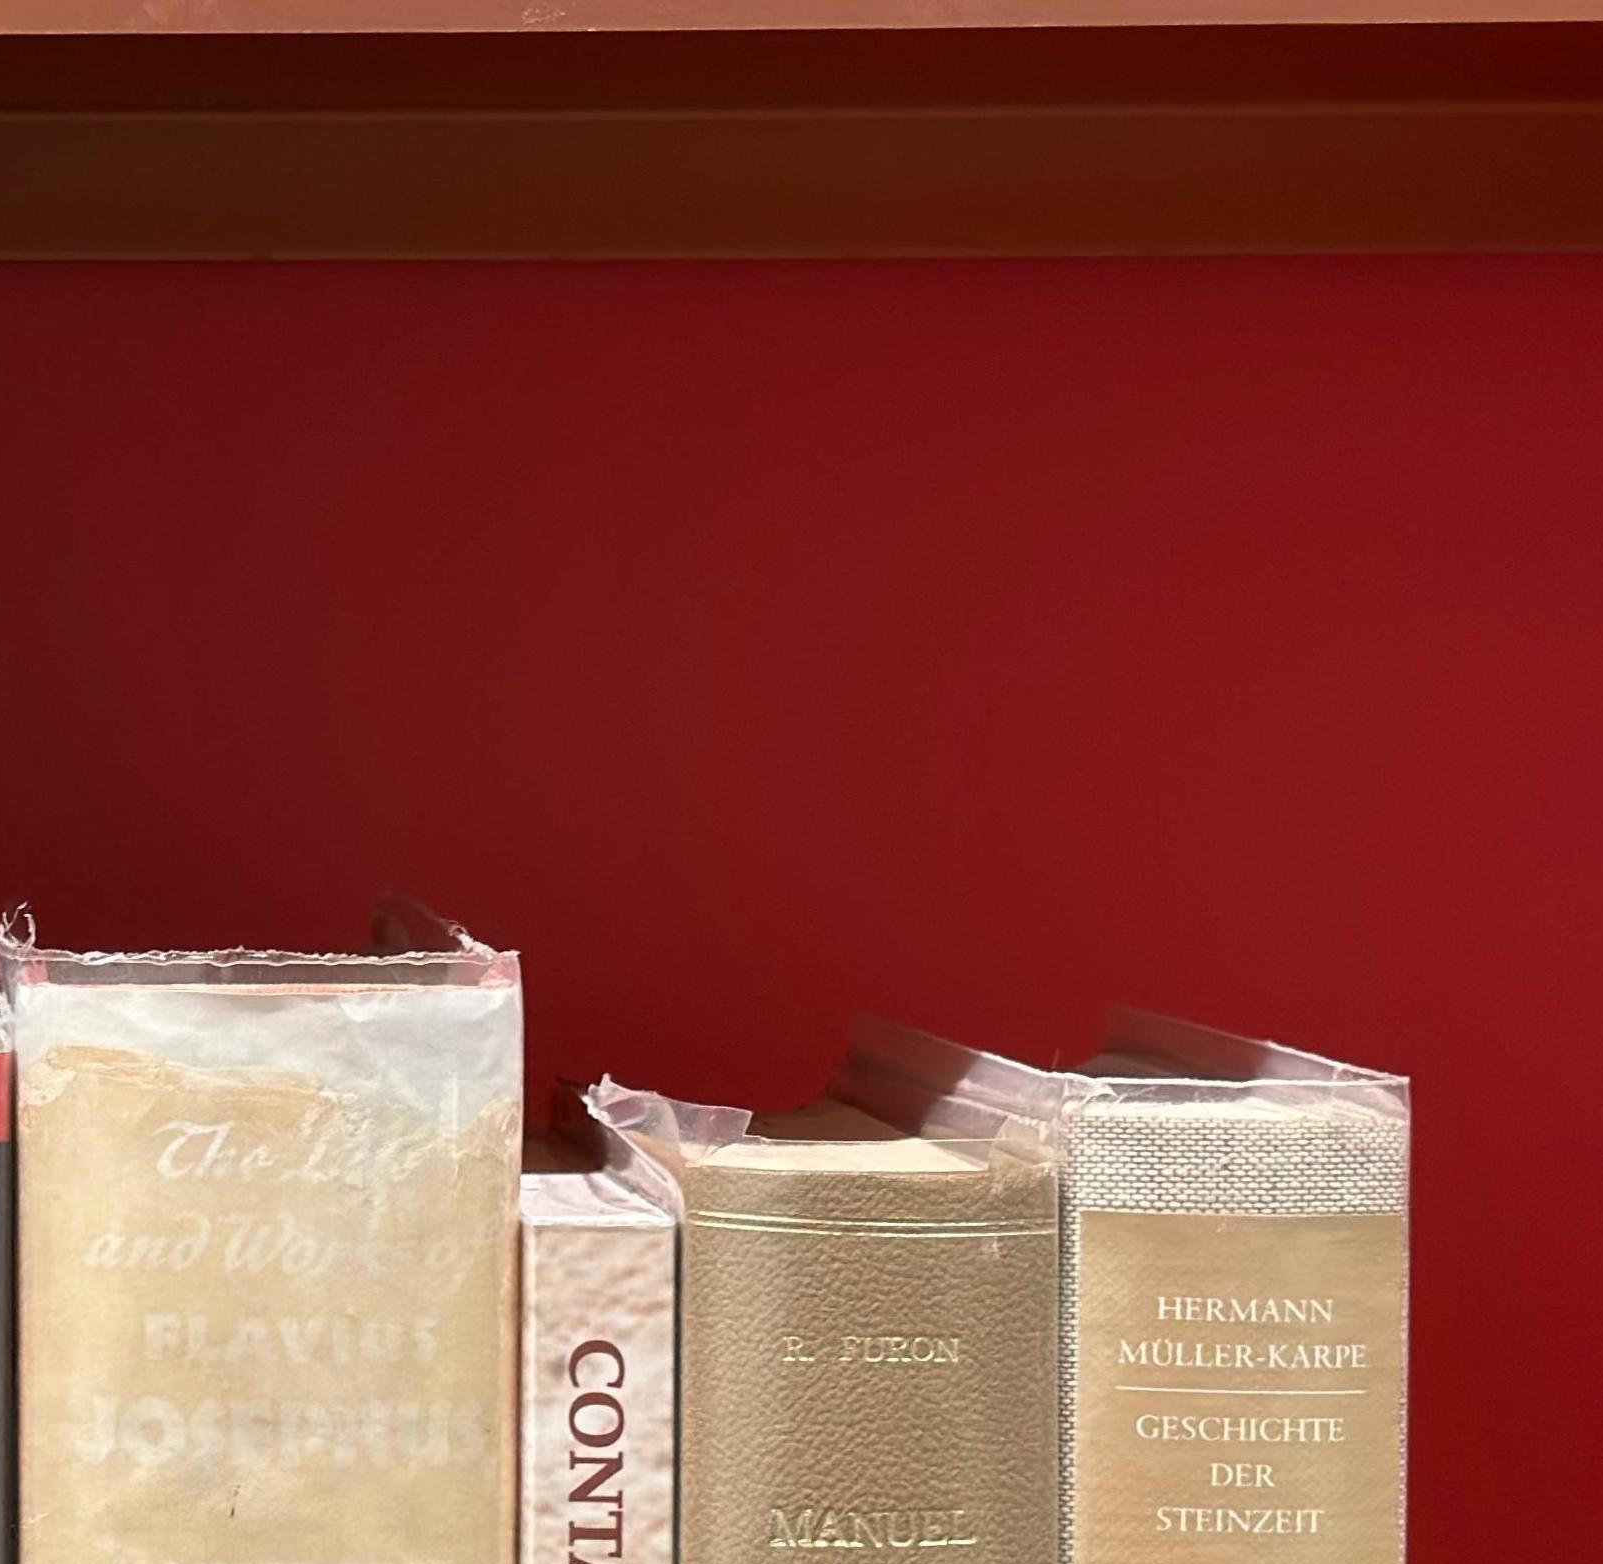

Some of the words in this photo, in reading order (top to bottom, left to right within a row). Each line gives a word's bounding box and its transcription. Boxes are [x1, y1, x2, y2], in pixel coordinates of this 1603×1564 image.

[153, 1120, 277, 1181] The
[84, 1212, 211, 1270] and
[1156, 1295, 1334, 1324] HERMANN
[142, 1312, 439, 1364] FLAVIUS
[783, 1336, 815, 1363] R.
[839, 1336, 961, 1363] FURON
[1118, 1338, 1367, 1369] MÜLLER-KARPE
[1135, 1413, 1345, 1442] GESCHICHTE
[1209, 1462, 1275, 1488] DER
[767, 1508, 978, 1549] MANUEL
[1155, 1506, 1325, 1534] STEINZEIT
